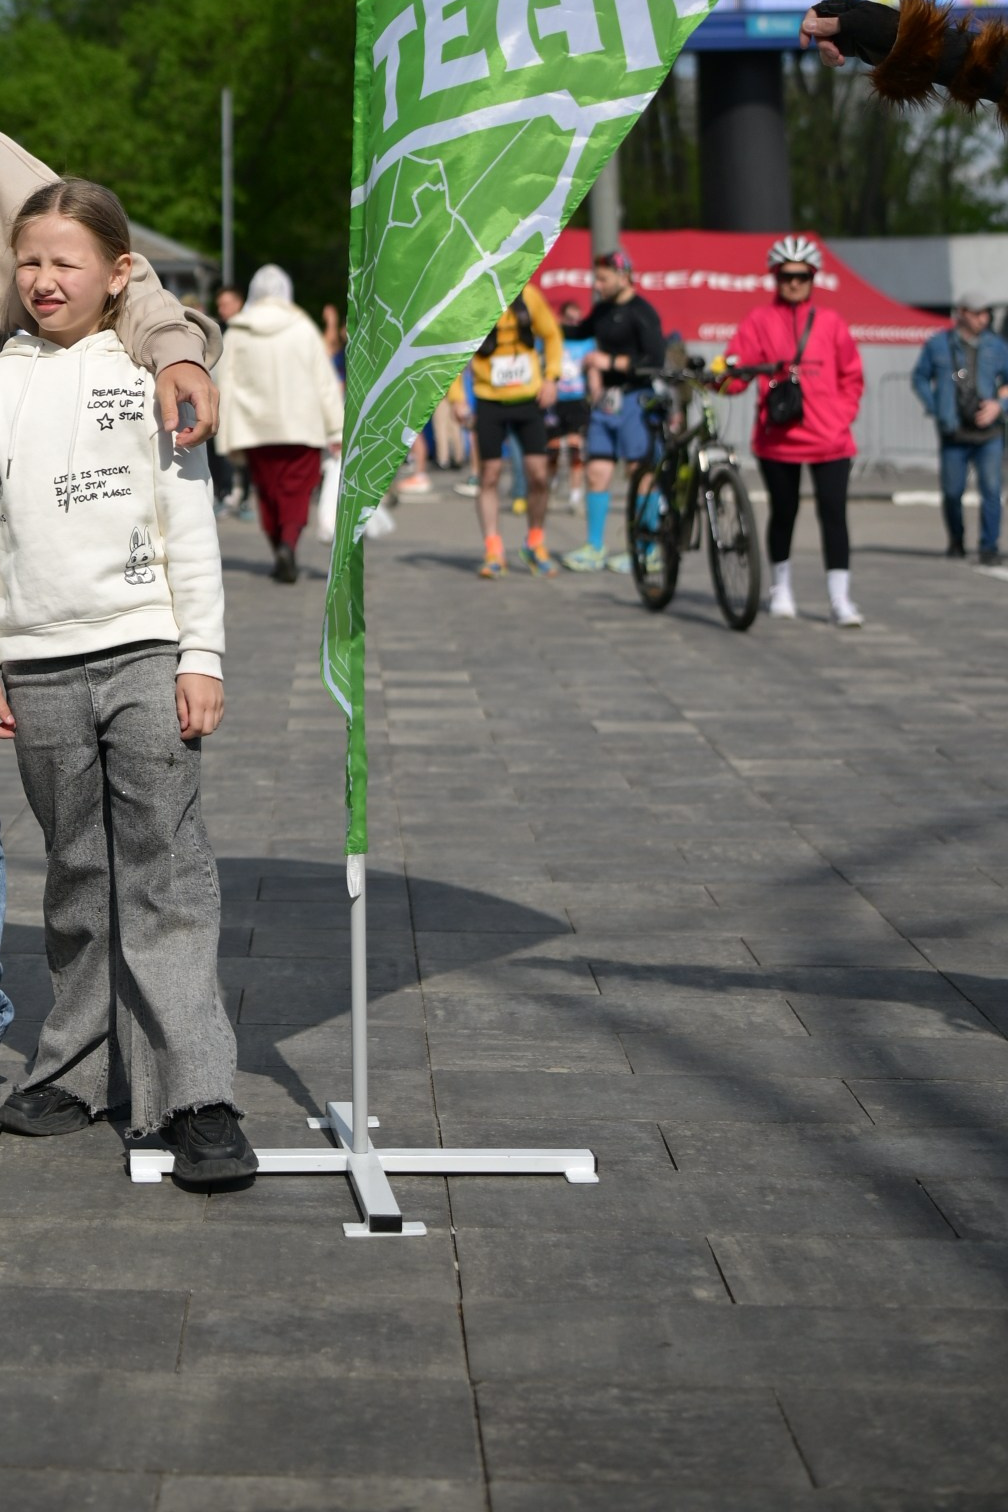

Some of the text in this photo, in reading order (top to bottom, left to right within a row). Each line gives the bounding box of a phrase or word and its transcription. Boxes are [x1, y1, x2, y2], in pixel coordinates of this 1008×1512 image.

[87, 399, 115, 409] LOOK
[119, 399, 134, 408] UP
[80, 470, 92, 479] IS
[85, 480, 107, 490] STAY
[73, 492, 98, 504] YOUR
[102, 488, 132, 499] MAGIC
